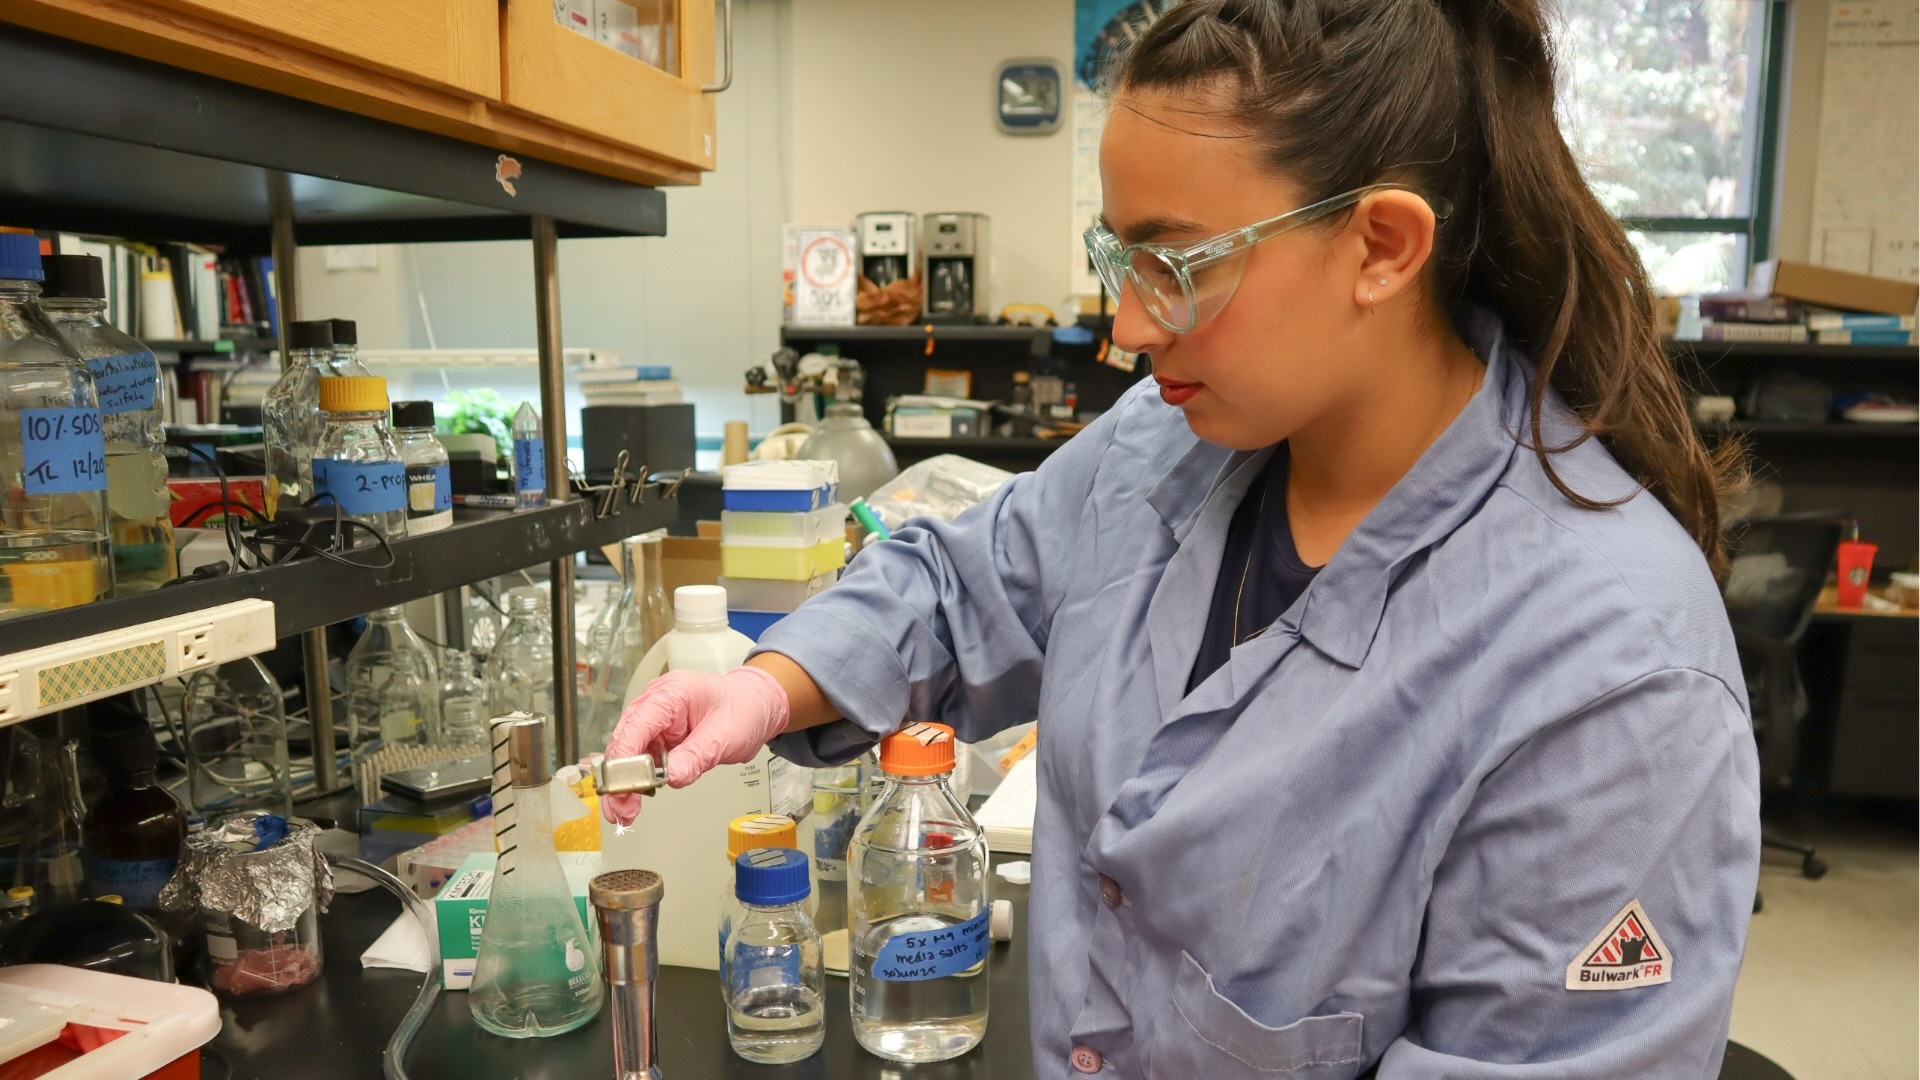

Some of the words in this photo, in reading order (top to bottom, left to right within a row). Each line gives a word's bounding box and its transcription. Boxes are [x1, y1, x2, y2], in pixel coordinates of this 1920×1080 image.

[28, 414, 67, 441] 10%
[71, 413, 100, 436] SDS
[28, 459, 59, 485] TL
[73, 451, 105, 481] 12/20
[895, 951, 935, 964] media
[938, 943, 969, 958] salts
[1580, 967, 1640, 982] Bulwark
[1643, 964, 1663, 978] FR
